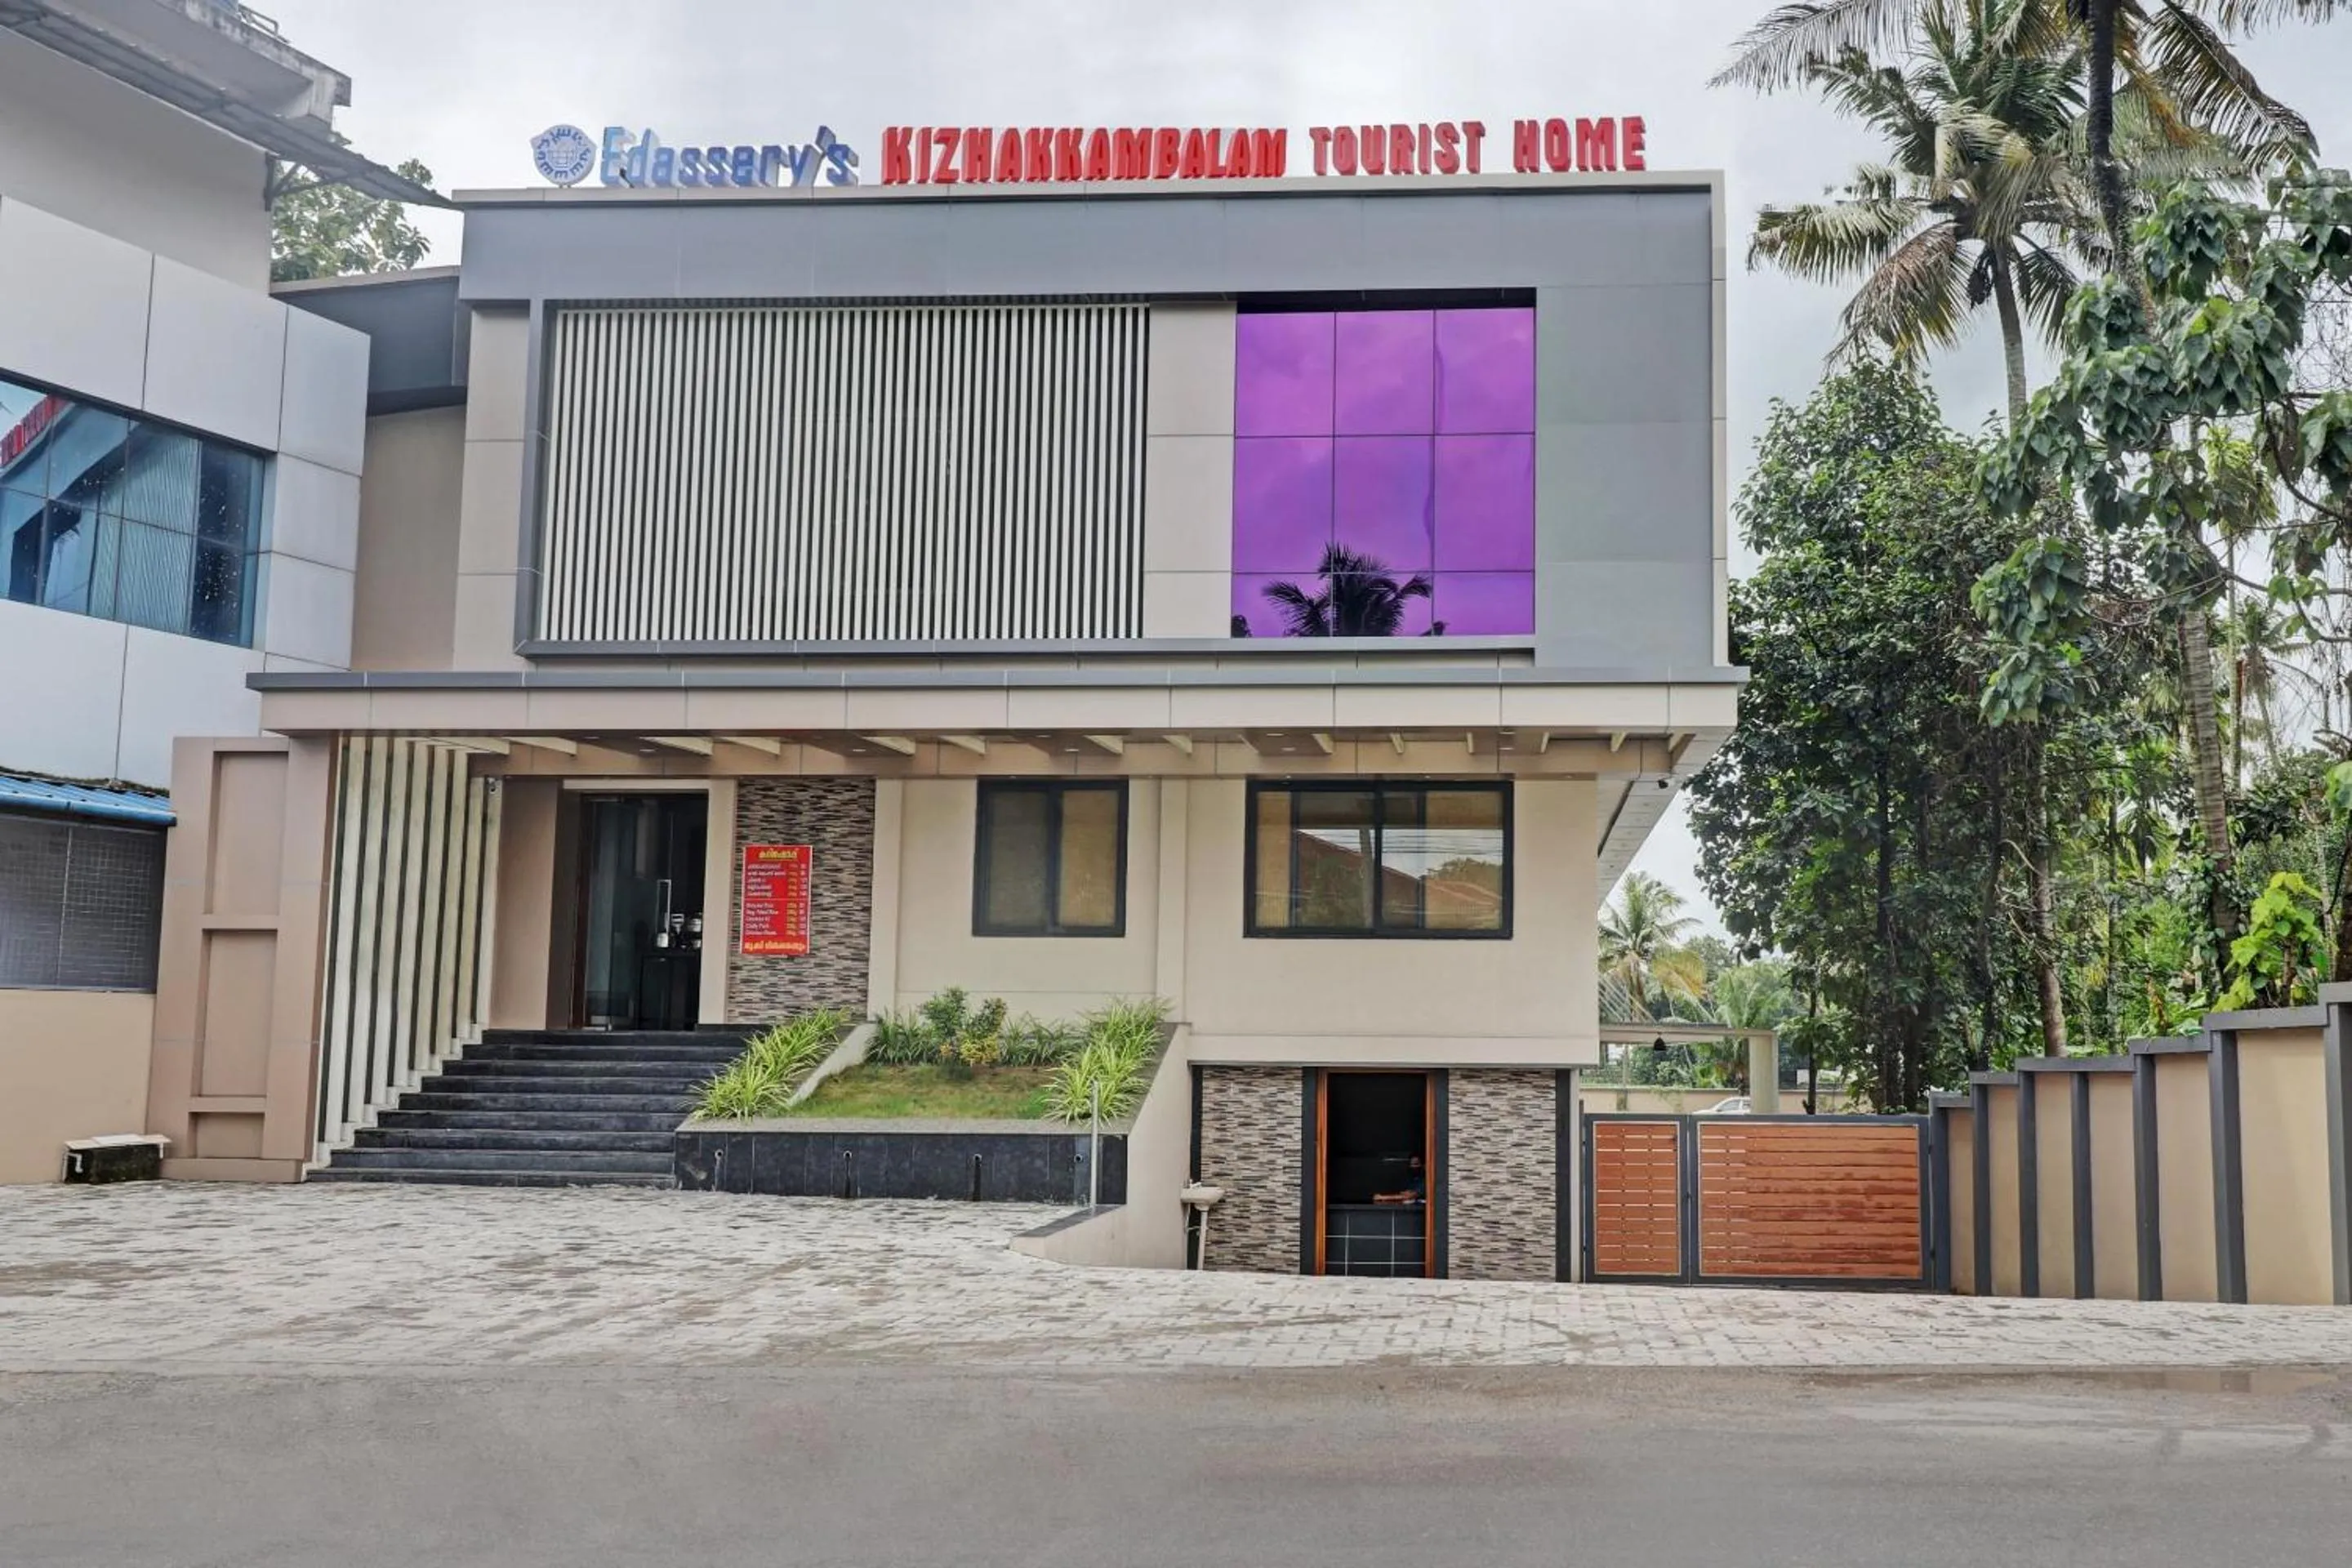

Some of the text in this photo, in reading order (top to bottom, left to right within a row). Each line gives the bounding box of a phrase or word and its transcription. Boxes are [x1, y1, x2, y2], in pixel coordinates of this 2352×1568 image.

[601, 126, 859, 188] Edassery's
[882, 127, 1288, 185] KIZHAKKAMBALAM
[1309, 121, 1486, 176] TOURIST
[1514, 115, 1647, 173] HOME
